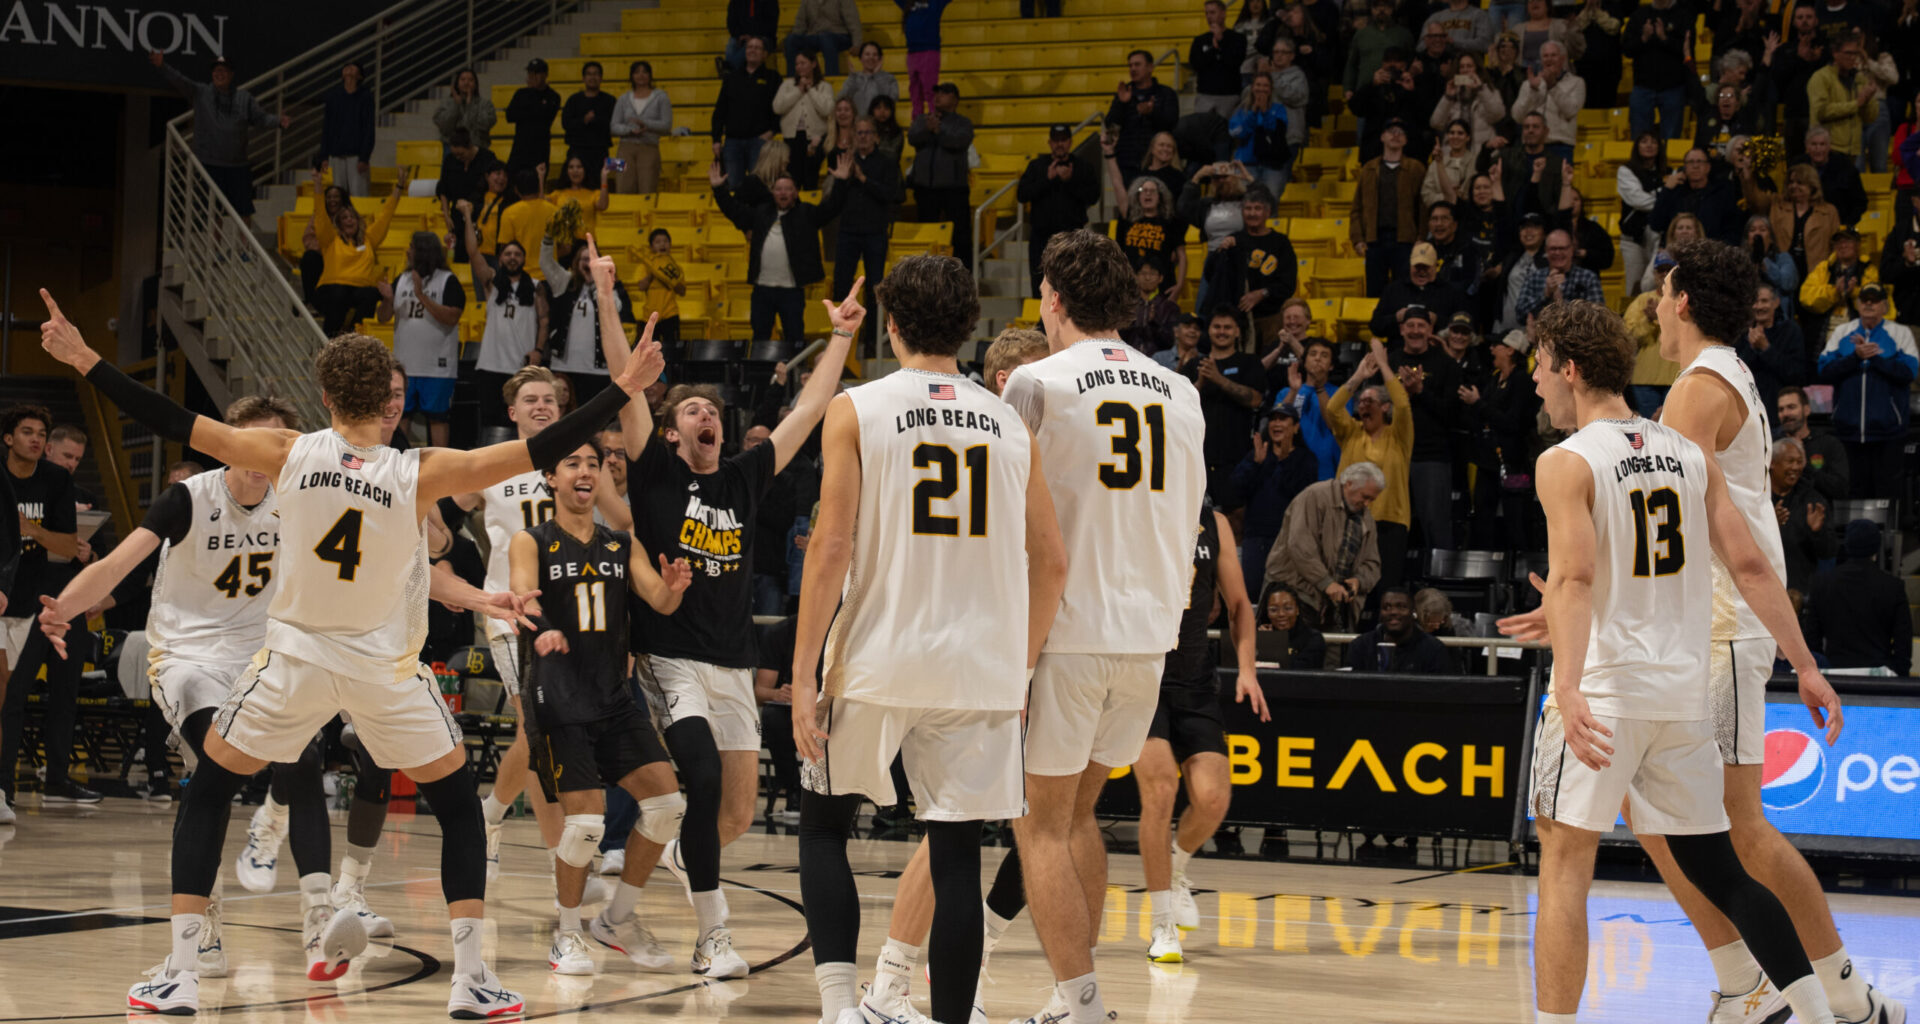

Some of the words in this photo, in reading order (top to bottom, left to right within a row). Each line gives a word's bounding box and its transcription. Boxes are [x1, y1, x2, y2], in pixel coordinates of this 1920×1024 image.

[0, 0, 229, 57] ANNON
[408, 301, 425, 318] 12
[577, 301, 588, 317] 4
[1076, 369, 1115, 394] LONG
[1119, 369, 1172, 400] BEACH
[896, 407, 937, 434] LONG
[942, 409, 1001, 439] BEACH
[1095, 400, 1166, 492] 31
[300, 471, 342, 490] LONG
[344, 476, 392, 508] BEACH
[911, 441, 989, 538] 21
[1614, 456, 1642, 483] LONG
[1640, 455, 1684, 479] BEACH
[685, 495, 744, 530] NATONAL
[1629, 486, 1685, 578] 13
[312, 507, 364, 582] 4
[679, 518, 742, 555] CHAMPS
[213, 551, 274, 598] 45
[549, 561, 624, 581] BEACH
[574, 581, 606, 632] 11
[1228, 733, 1505, 798] BEACH
[1836, 753, 1920, 803] pe
